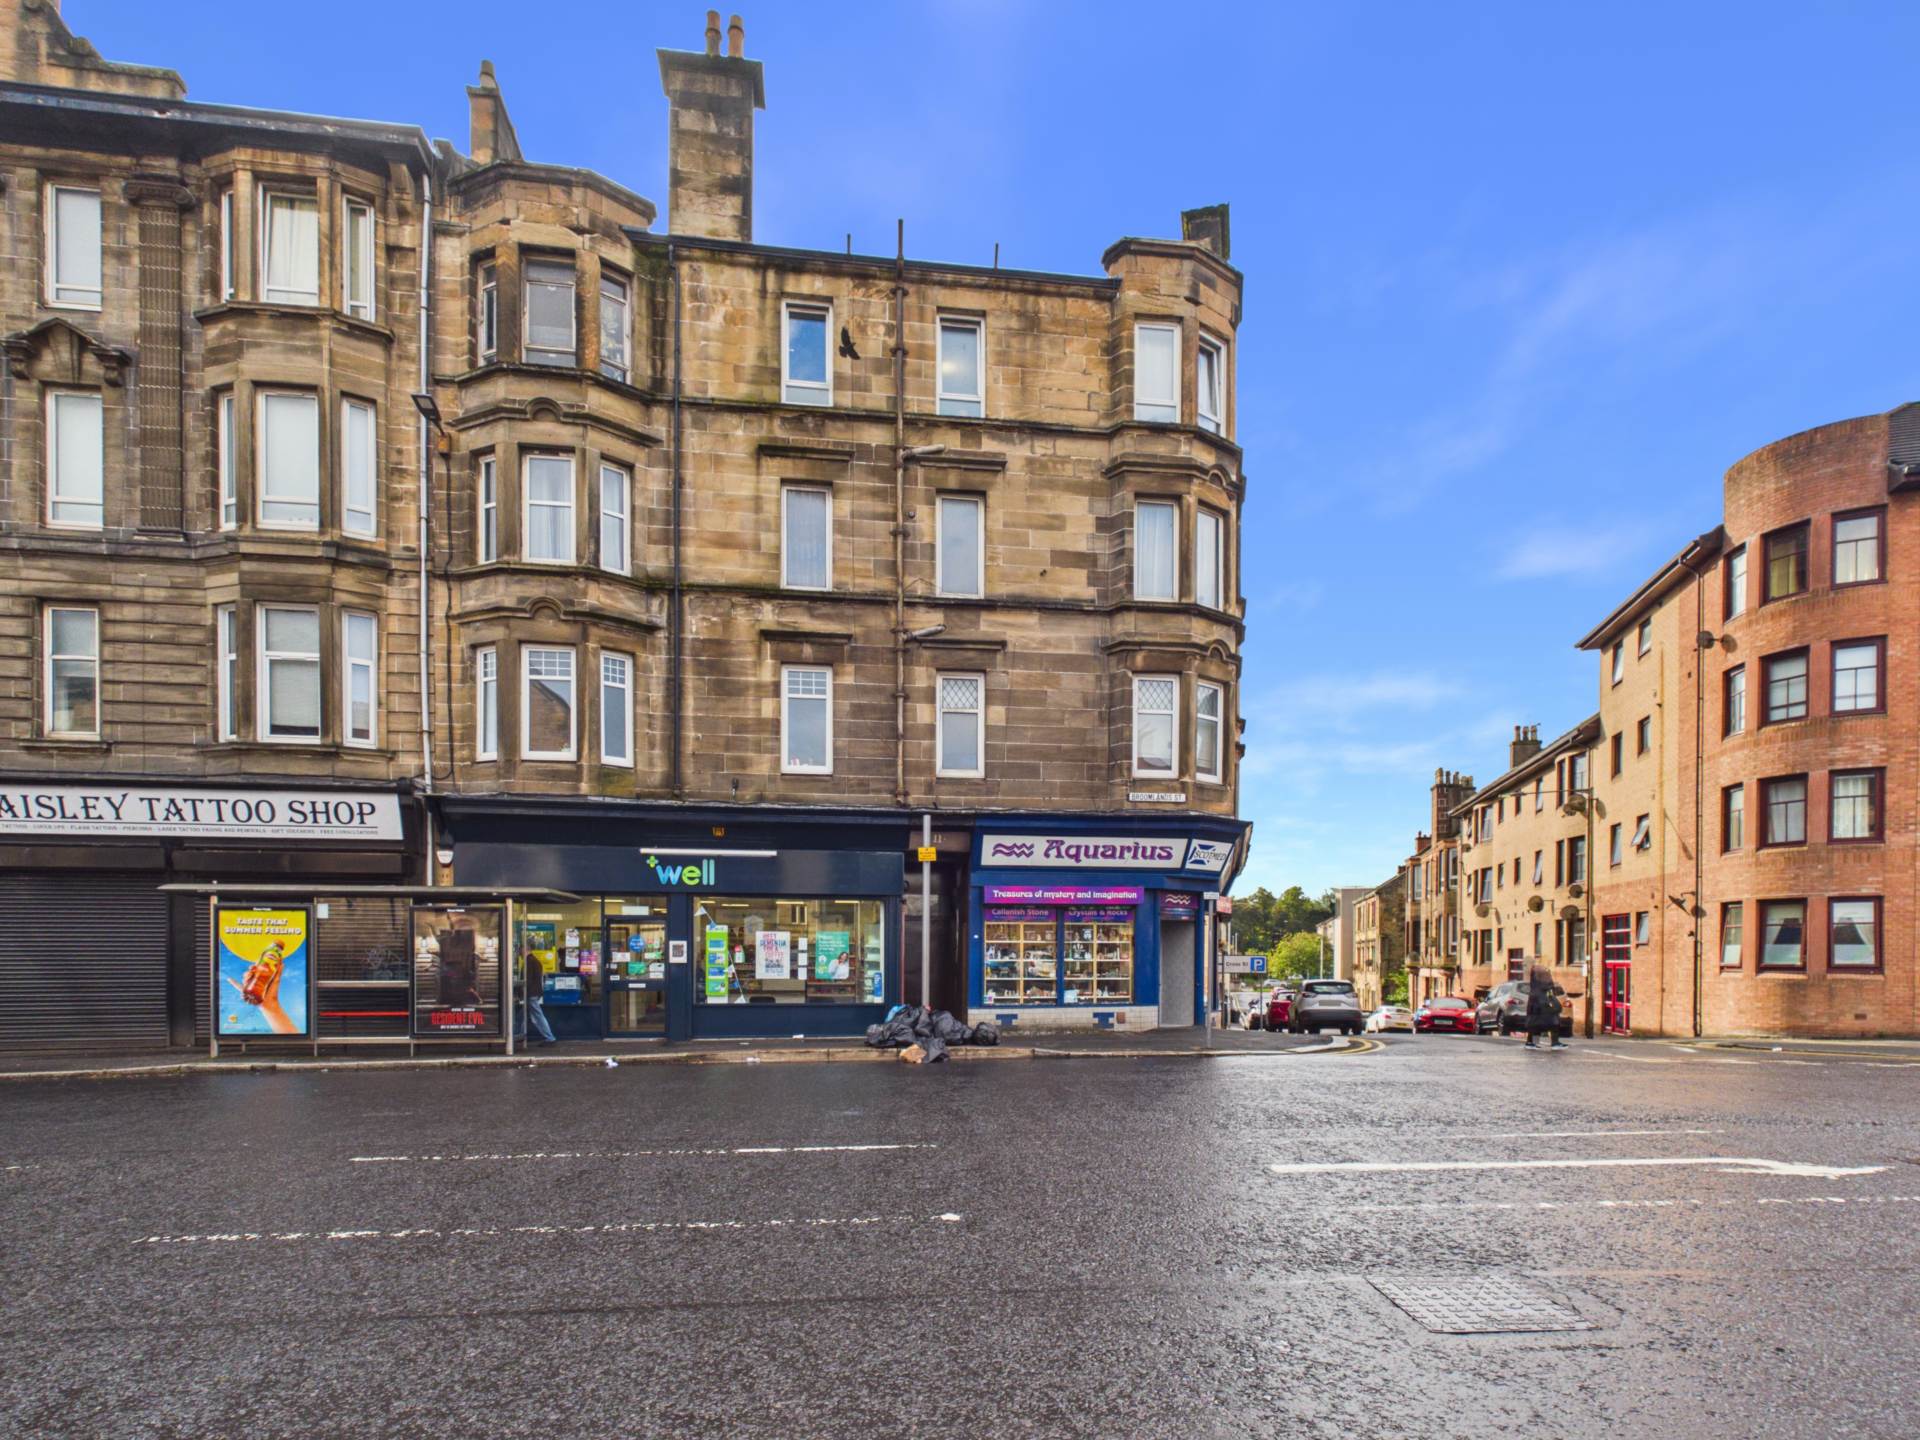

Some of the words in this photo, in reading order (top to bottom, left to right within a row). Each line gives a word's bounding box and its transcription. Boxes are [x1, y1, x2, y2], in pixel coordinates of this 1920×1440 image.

[1131, 793, 1172, 801] BROOMLANDS
[139, 797, 276, 824] TATTOO
[288, 800, 376, 825] SHOP
[1043, 839, 1174, 863] Aquarius
[656, 858, 715, 886] well
[993, 889, 1033, 898] Treasures
[1034, 890, 1043, 898] of
[1043, 891, 1075, 900] mystery
[1076, 891, 1092, 899] and
[1093, 891, 1137, 900] imagination
[1027, 908, 1049, 916] Stone
[237, 918, 262, 926] TASTE
[266, 918, 288, 926] THAT
[225, 926, 262, 934] SUMMER
[265, 927, 302, 935] FEELING
[1254, 959, 1263, 971] P
[431, 1011, 466, 1025] RESIDENT
[467, 1012, 485, 1025] EVIL
